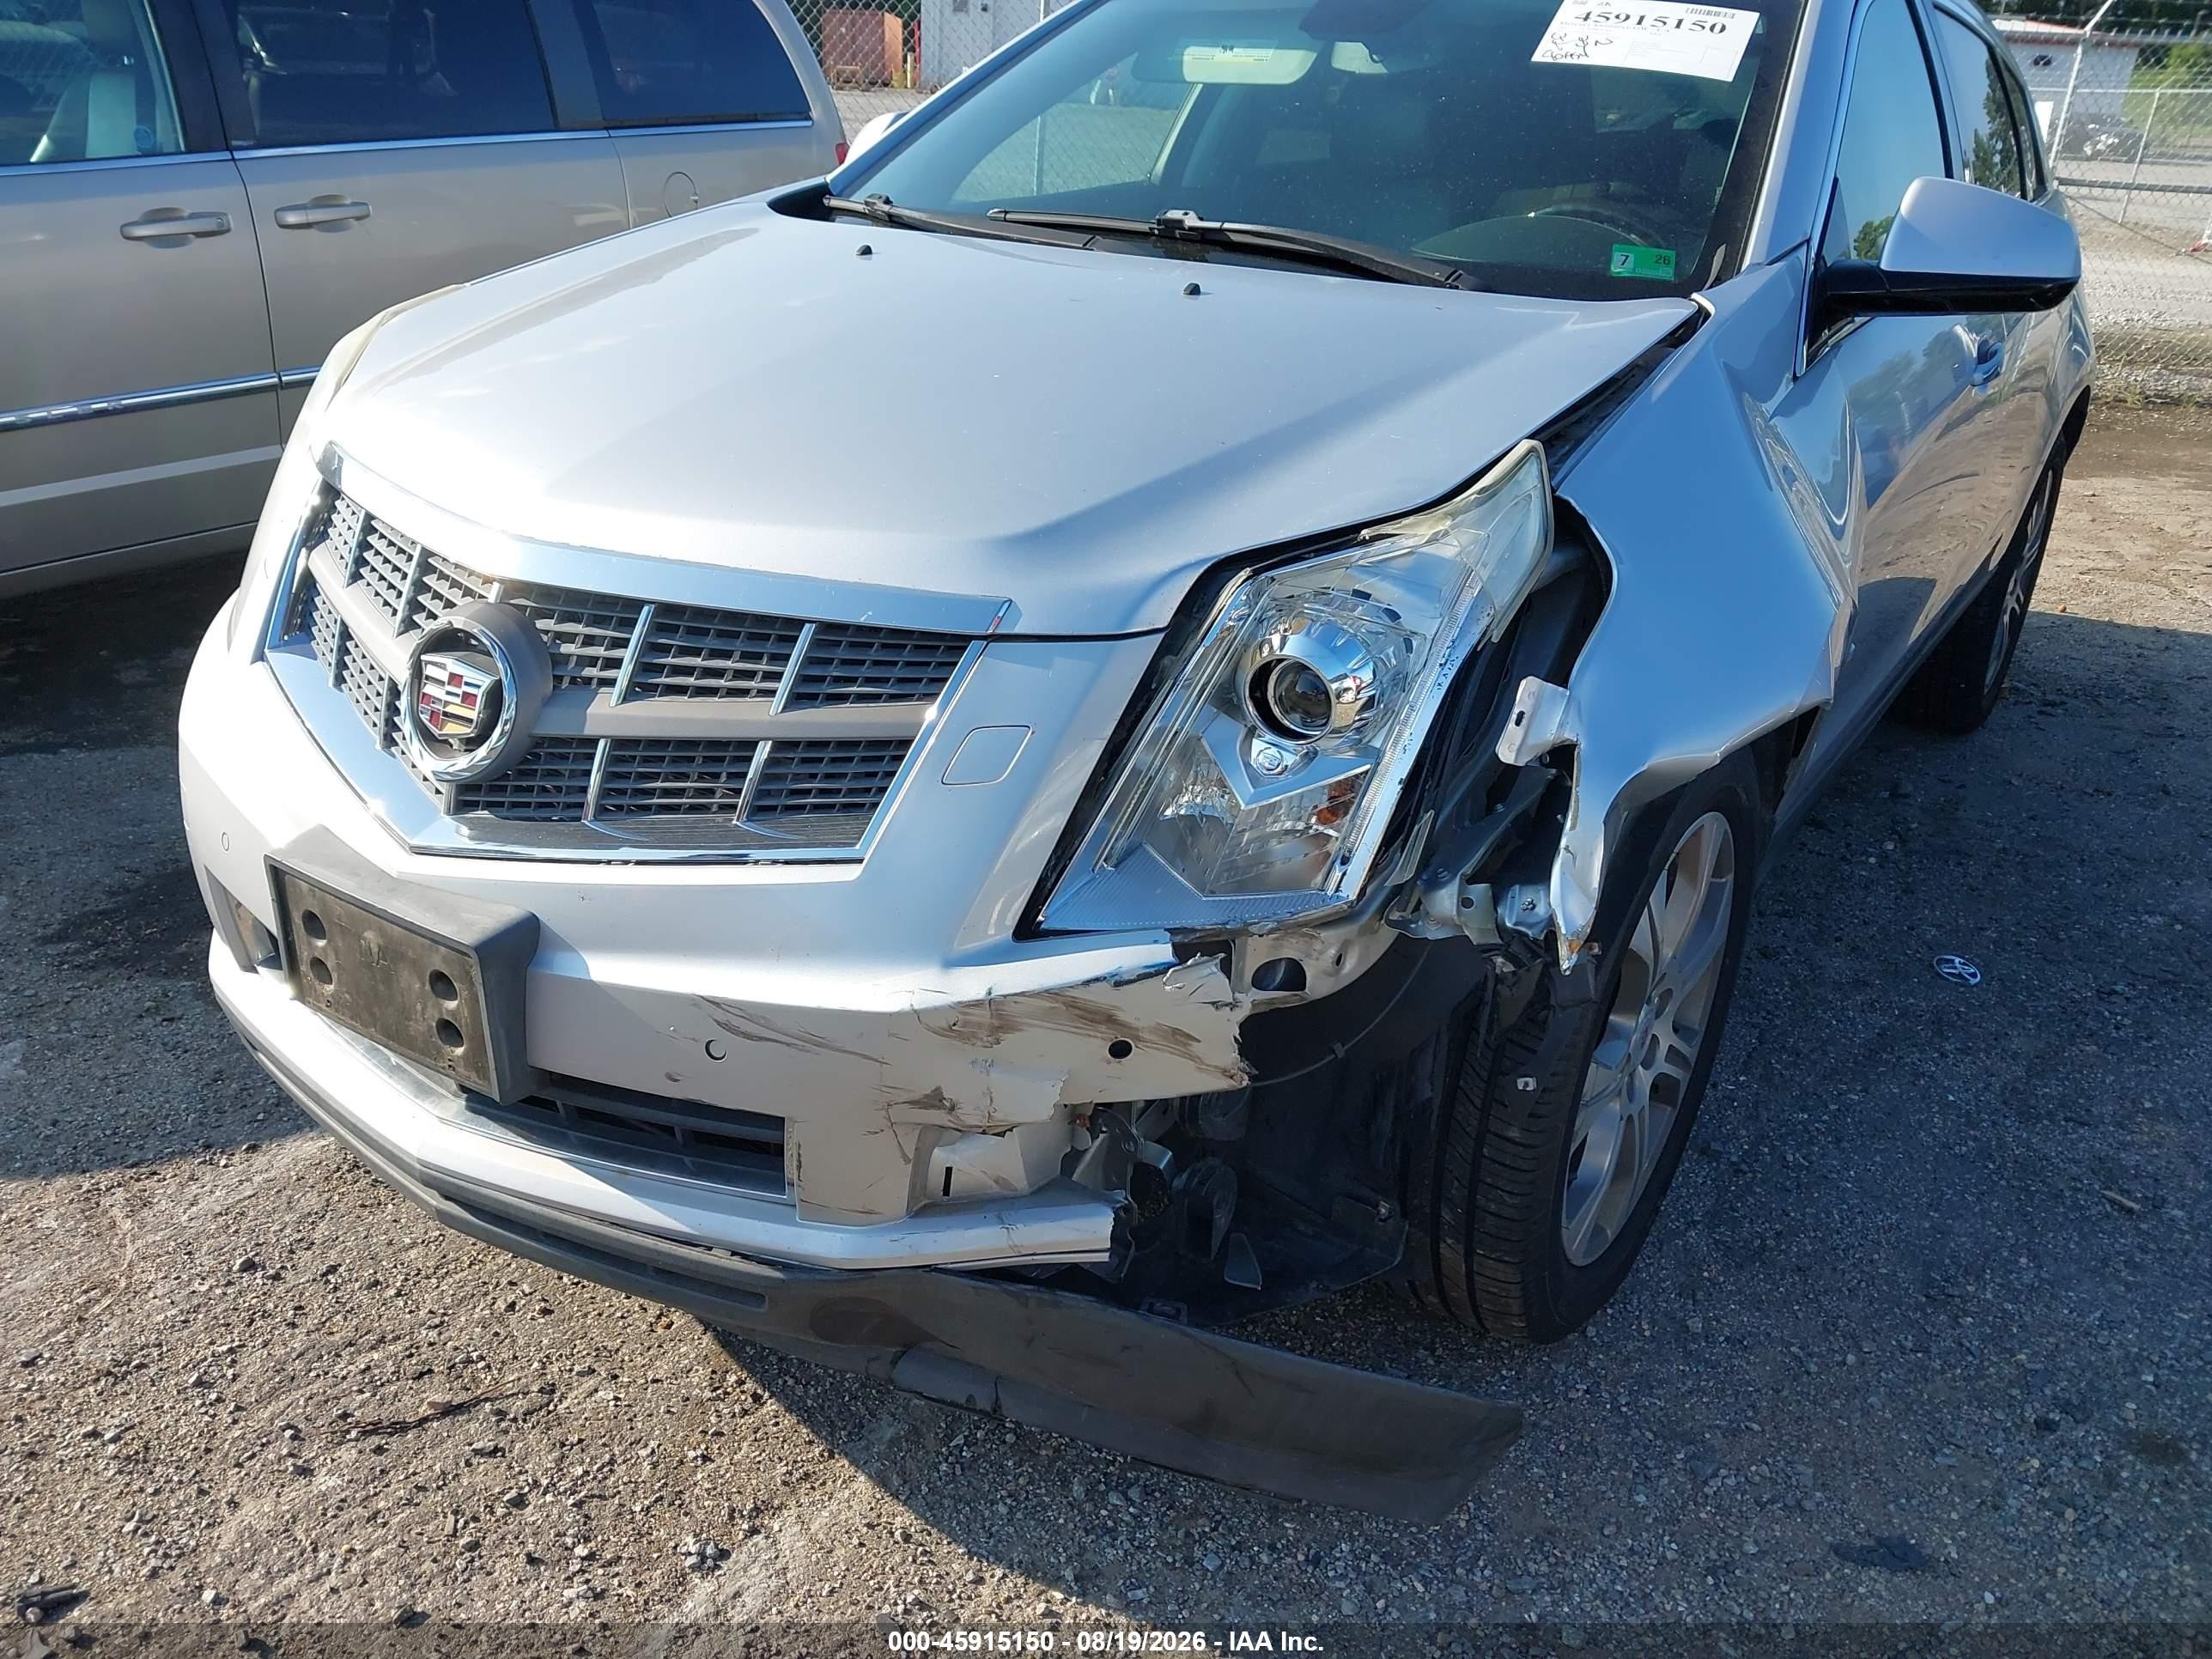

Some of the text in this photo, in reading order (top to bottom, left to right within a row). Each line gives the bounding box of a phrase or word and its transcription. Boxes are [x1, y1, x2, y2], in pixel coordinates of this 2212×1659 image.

[1573, 10, 1728, 35] 45915150
[1620, 253, 1630, 266] 7
[1654, 253, 1671, 265] 26
